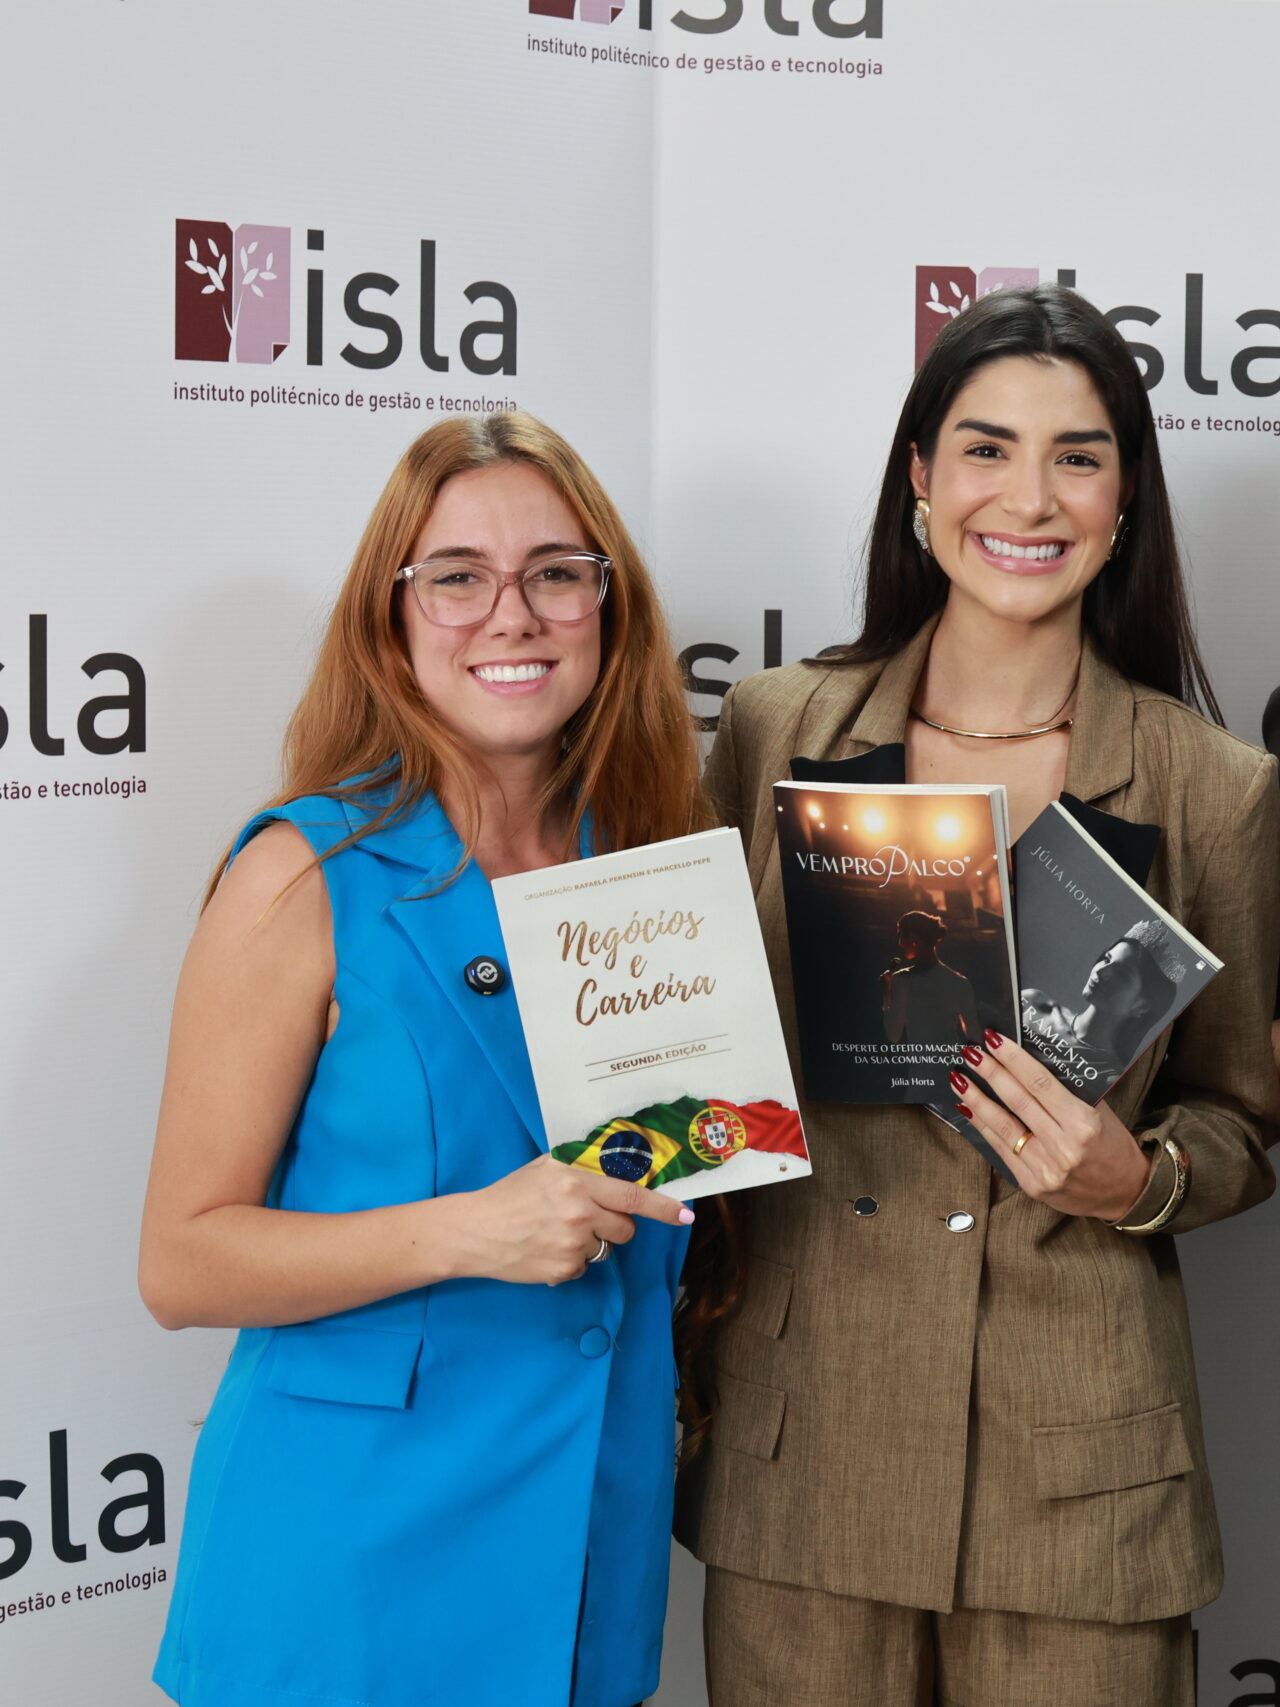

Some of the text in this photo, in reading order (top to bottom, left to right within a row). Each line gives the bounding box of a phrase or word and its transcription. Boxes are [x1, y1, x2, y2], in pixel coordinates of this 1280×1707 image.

[527, 34, 883, 78] instituto politécnico de gestão e tecnologia
[307, 229, 518, 376] isla
[174, 382, 518, 414] instituto politécnico de gestão e tecnologia
[1191, 419, 1201, 431] e
[0, 614, 146, 756] la
[38, 785, 48, 798] e
[54, 776, 146, 799] tecnologia
[523, 885, 573, 901] ORGANIZAÇÃO
[574, 878, 608, 891] RAFAELA
[609, 870, 645, 883] PERENSIN
[652, 861, 692, 875] MARCELLO
[693, 856, 711, 867] PEPE
[1031, 845, 1106, 926] JÚLIA HORTA
[557, 910, 705, 970] Negócios
[630, 954, 648, 979] e
[575, 973, 716, 1027] Carreira
[610, 1043, 706, 1072] SEGUNDA EDIÇÃO
[832, 1043, 877, 1053] DESPERTE
[880, 1044, 889, 1053] O
[890, 1044, 923, 1053] EFEITO
[855, 1055, 964, 1067] DA SUA COMUNICAÇÃO
[891, 1077, 935, 1088] Júlia Horta
[61, 1591, 71, 1604] e
[77, 1566, 167, 1601] tecnologia
